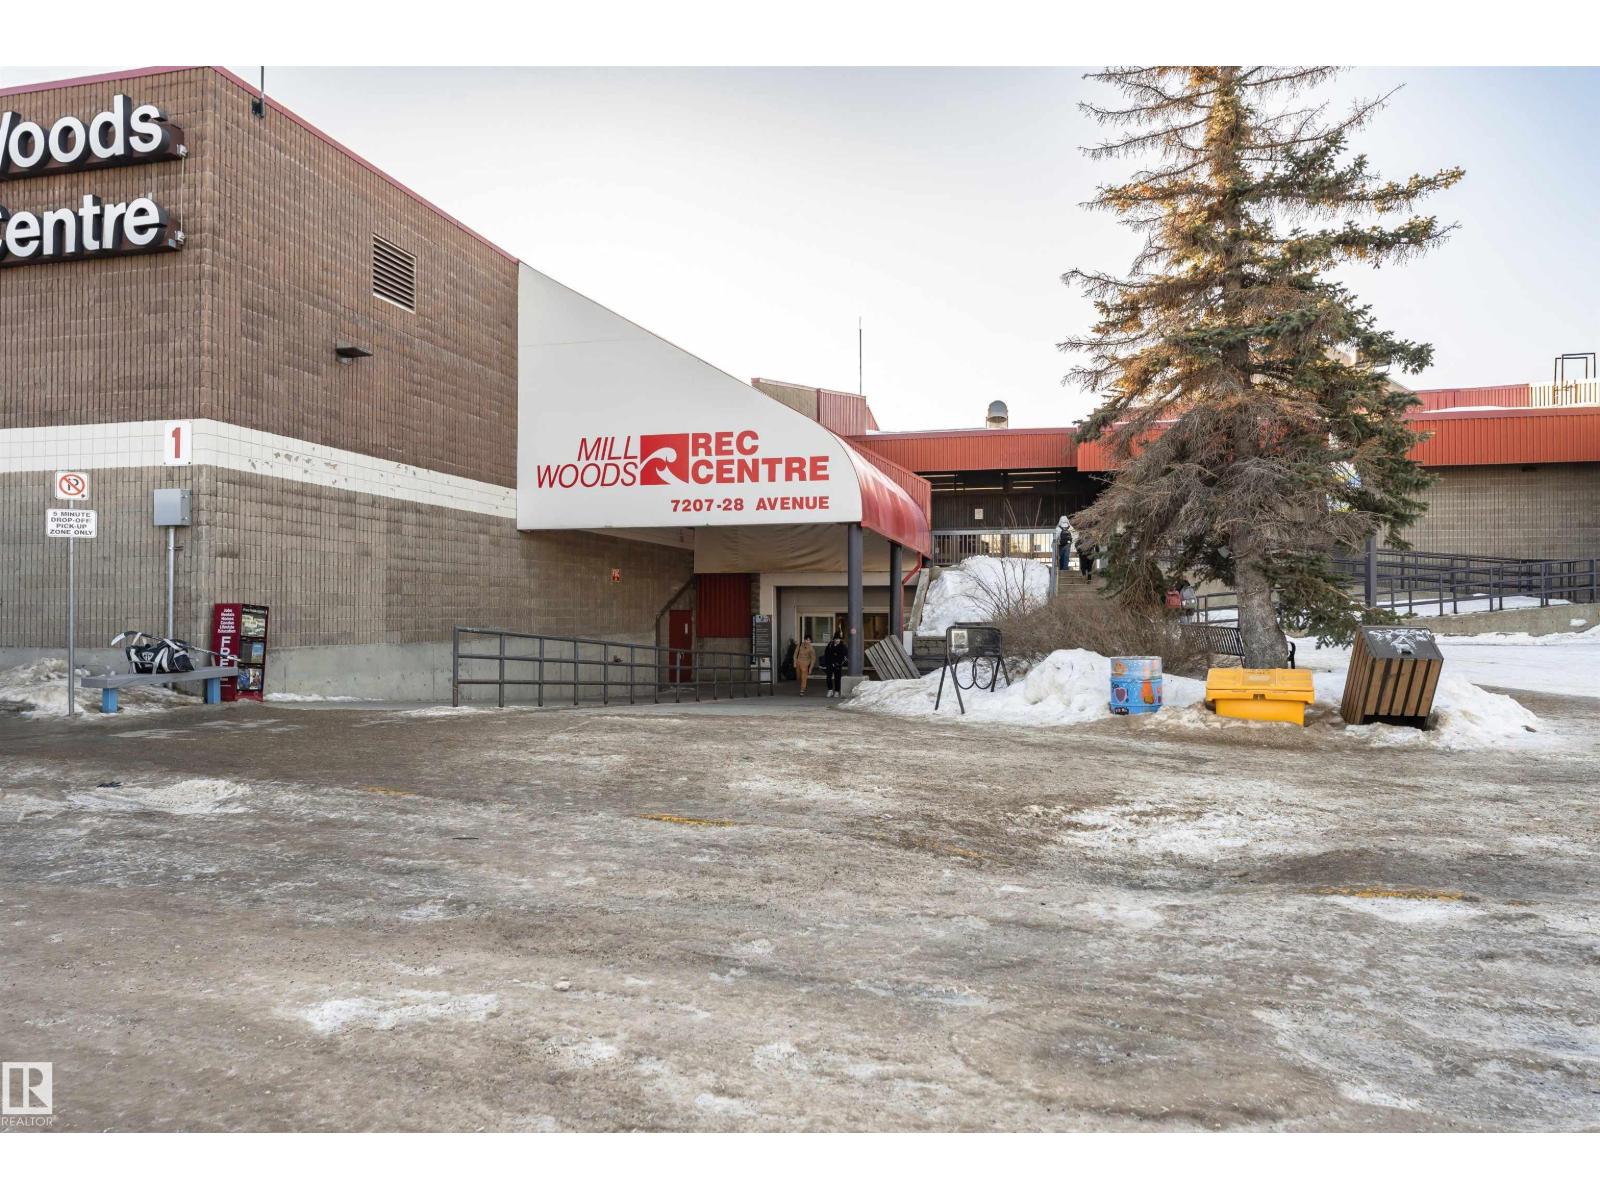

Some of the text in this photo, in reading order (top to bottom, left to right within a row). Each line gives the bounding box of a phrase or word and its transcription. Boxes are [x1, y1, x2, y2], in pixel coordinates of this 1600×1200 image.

[0, 94, 163, 168] oods
[0, 194, 160, 257] entre
[171, 427, 181, 459] 1
[577, 436, 638, 461] MILL
[691, 430, 759, 457] REC
[537, 461, 638, 488] WOODS
[691, 456, 830, 485] CENTRE
[671, 496, 830, 512] 7207-28 AVENUE
